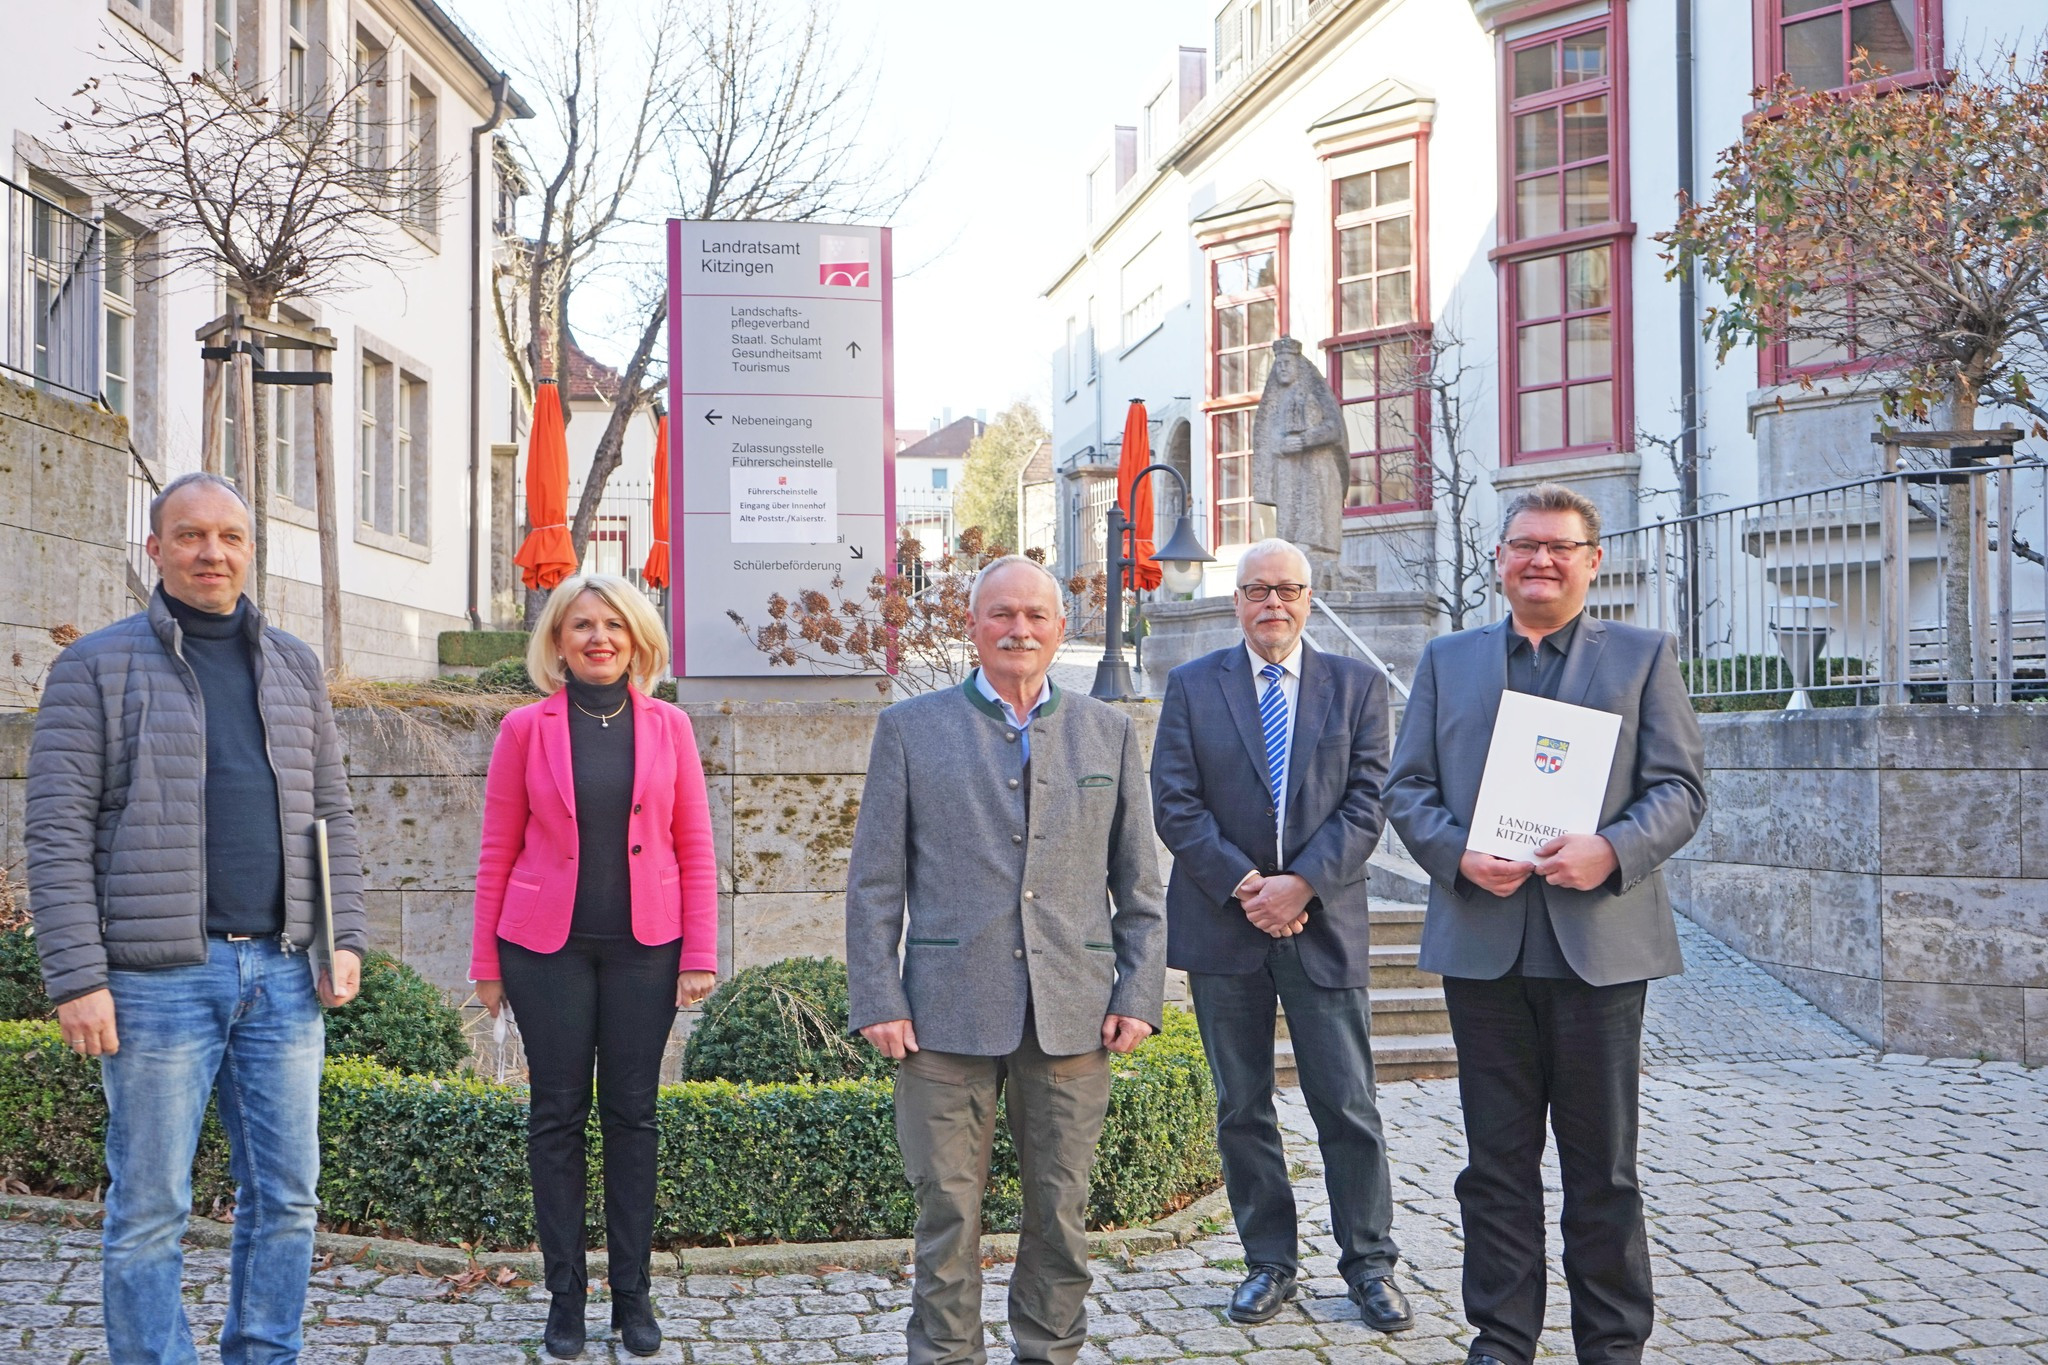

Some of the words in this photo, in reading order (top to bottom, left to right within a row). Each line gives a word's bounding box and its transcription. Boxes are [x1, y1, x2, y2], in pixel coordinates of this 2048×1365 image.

[701, 239, 801, 256] Landratsamt
[701, 259, 774, 276] Kitzingen
[731, 306, 802, 318] Landschafts-
[731, 318, 810, 330] pflegeverband
[731, 334, 767, 345] Staatl.
[770, 335, 822, 346] Schulamt
[731, 348, 822, 360] Gesundheitsamt
[732, 361, 790, 373] Tourismus
[732, 415, 813, 429] Nebeneingang
[732, 442, 825, 456] Zulassungsstelle
[732, 456, 834, 468] Führerscheinstelle
[747, 487, 818, 496] Führerscheinstelle
[739, 502, 770, 511] Eingang
[772, 502, 790, 510] über
[791, 502, 826, 510] Innenhof
[733, 560, 842, 573] Schülerbeförderung
